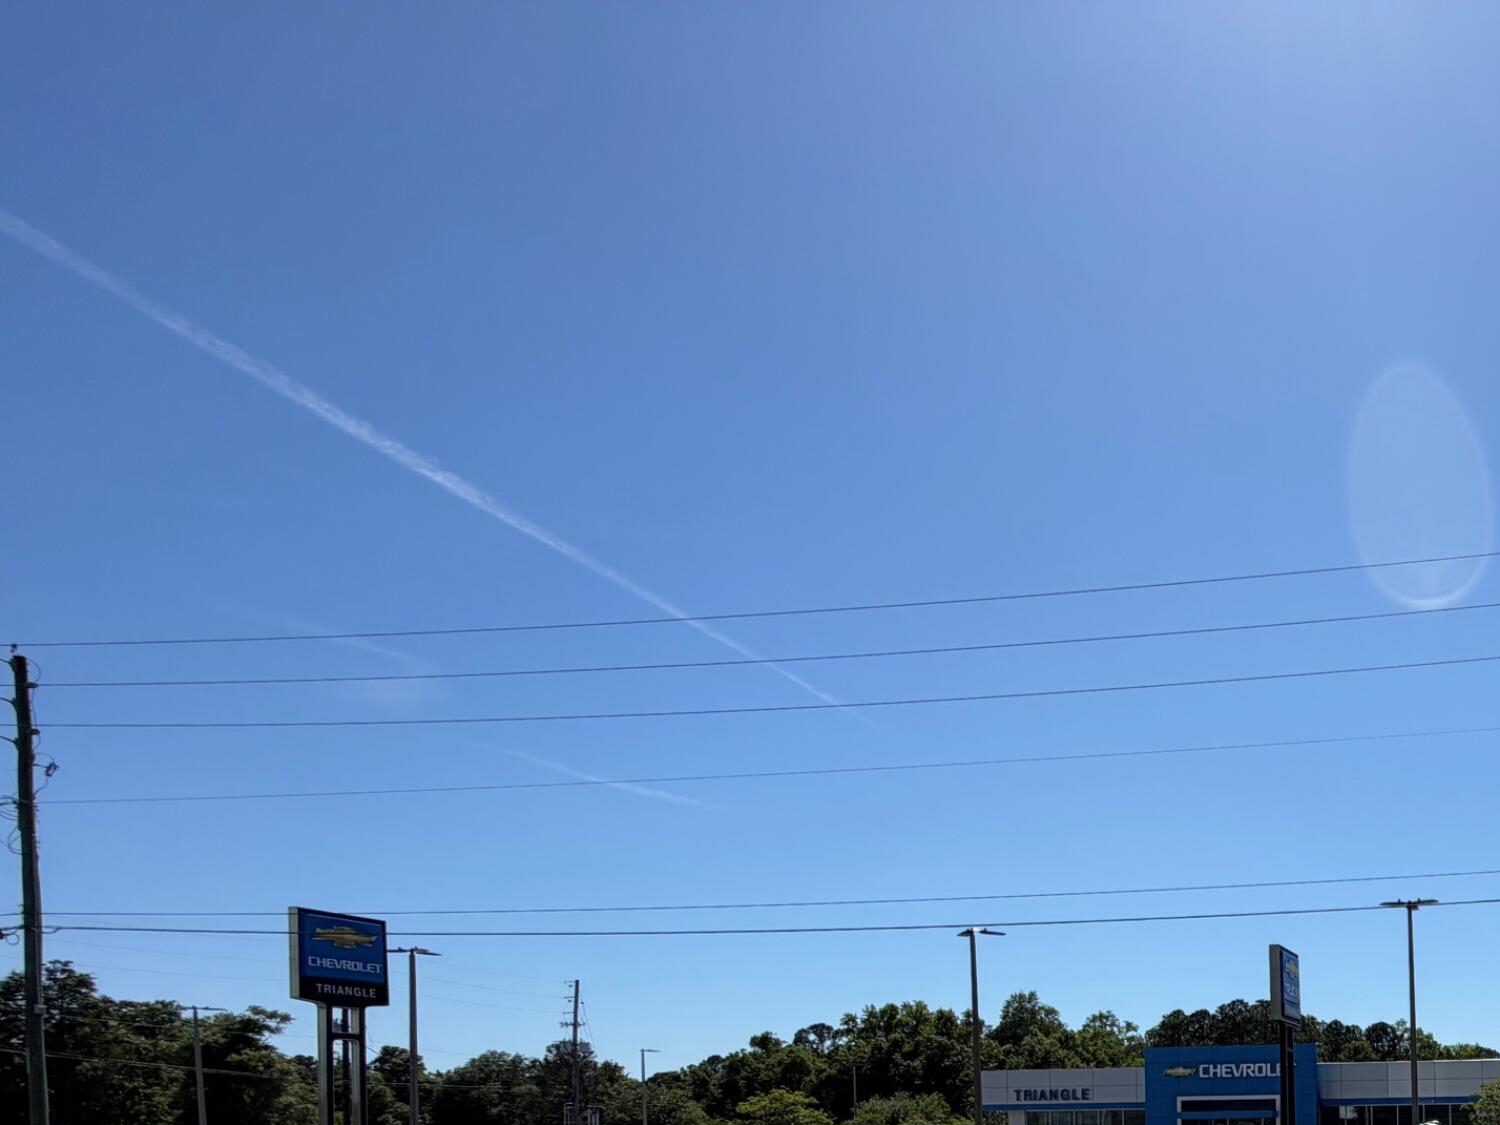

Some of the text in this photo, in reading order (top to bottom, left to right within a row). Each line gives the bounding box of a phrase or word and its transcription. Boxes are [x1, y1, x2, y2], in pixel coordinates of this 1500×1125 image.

[307, 956, 382, 974] CHEVROLET
[316, 983, 377, 998] TRIANGLE
[1199, 1063, 1281, 1078] CHEVROL
[1013, 1088, 1091, 1102] TRIANGLE
